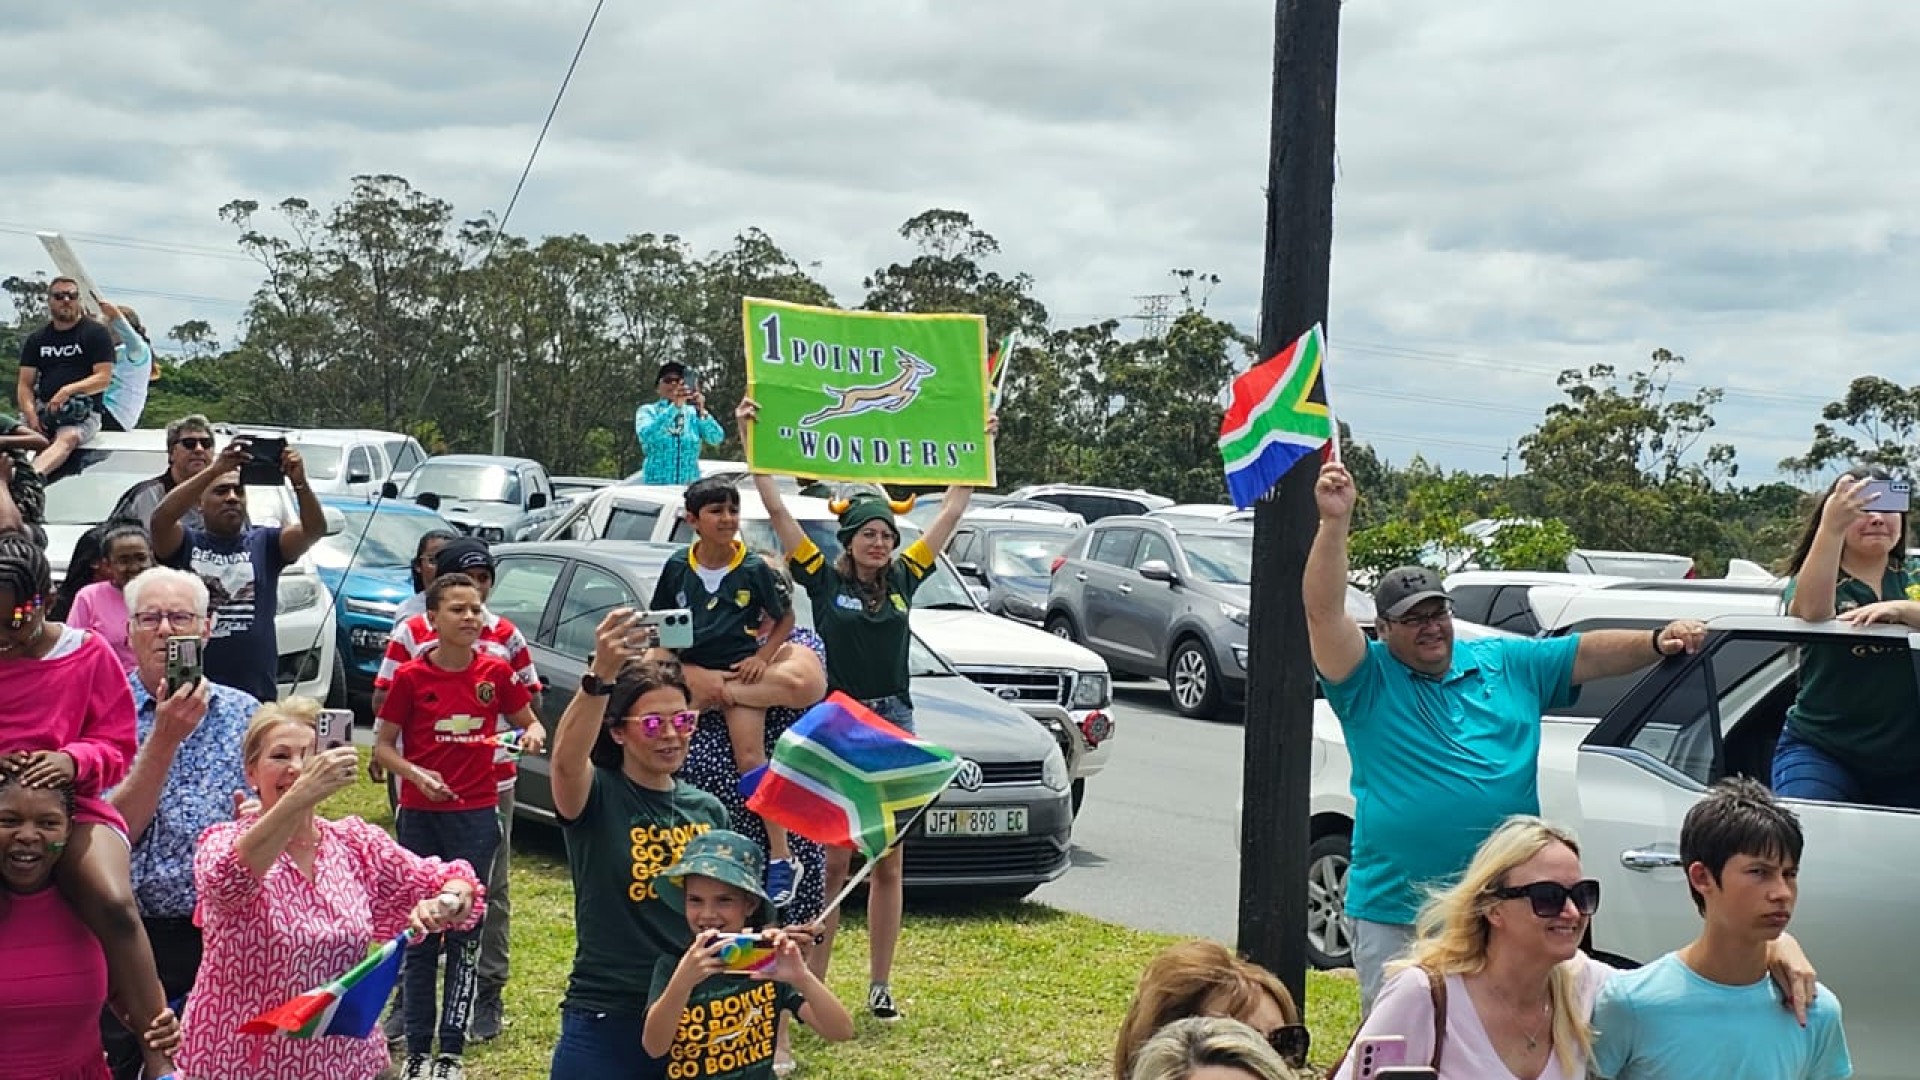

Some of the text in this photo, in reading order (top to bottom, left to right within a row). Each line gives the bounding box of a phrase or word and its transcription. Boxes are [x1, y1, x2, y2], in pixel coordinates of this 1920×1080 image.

[40, 343, 83, 358] RVCA
[761, 313, 884, 375] 1 POINT
[779, 427, 975, 467] "WONDERS"
[929, 810, 1023, 832] JFH 898 EC
[710, 981, 777, 1019] BOKKE
[668, 1039, 774, 1080] GO BOKKE
